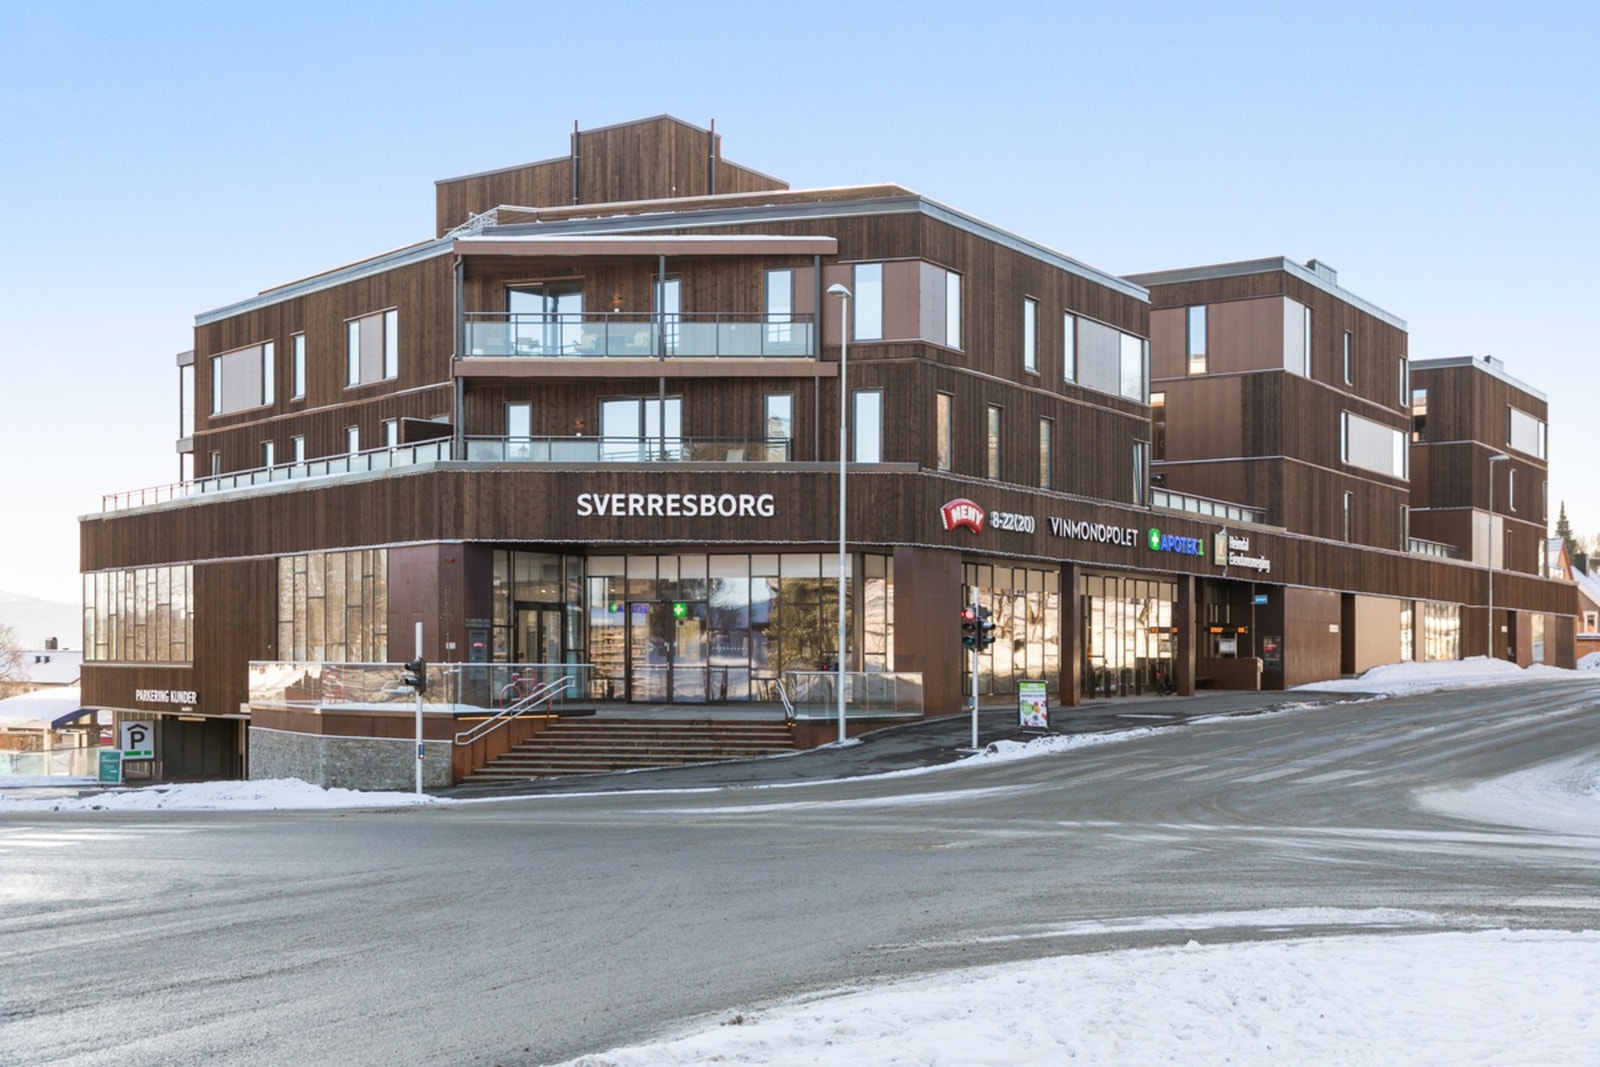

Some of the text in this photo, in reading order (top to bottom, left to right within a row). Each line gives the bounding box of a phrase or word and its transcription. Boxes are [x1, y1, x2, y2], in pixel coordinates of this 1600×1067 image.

[576, 493, 775, 517] SVERRESBORG
[951, 504, 984, 526] MENY
[990, 510, 1035, 534] 8-22(20)
[1050, 516, 1139, 547] VINMONOPOLET
[135, 688, 197, 704] PARKERING KUNDER
[130, 731, 145, 750] P
